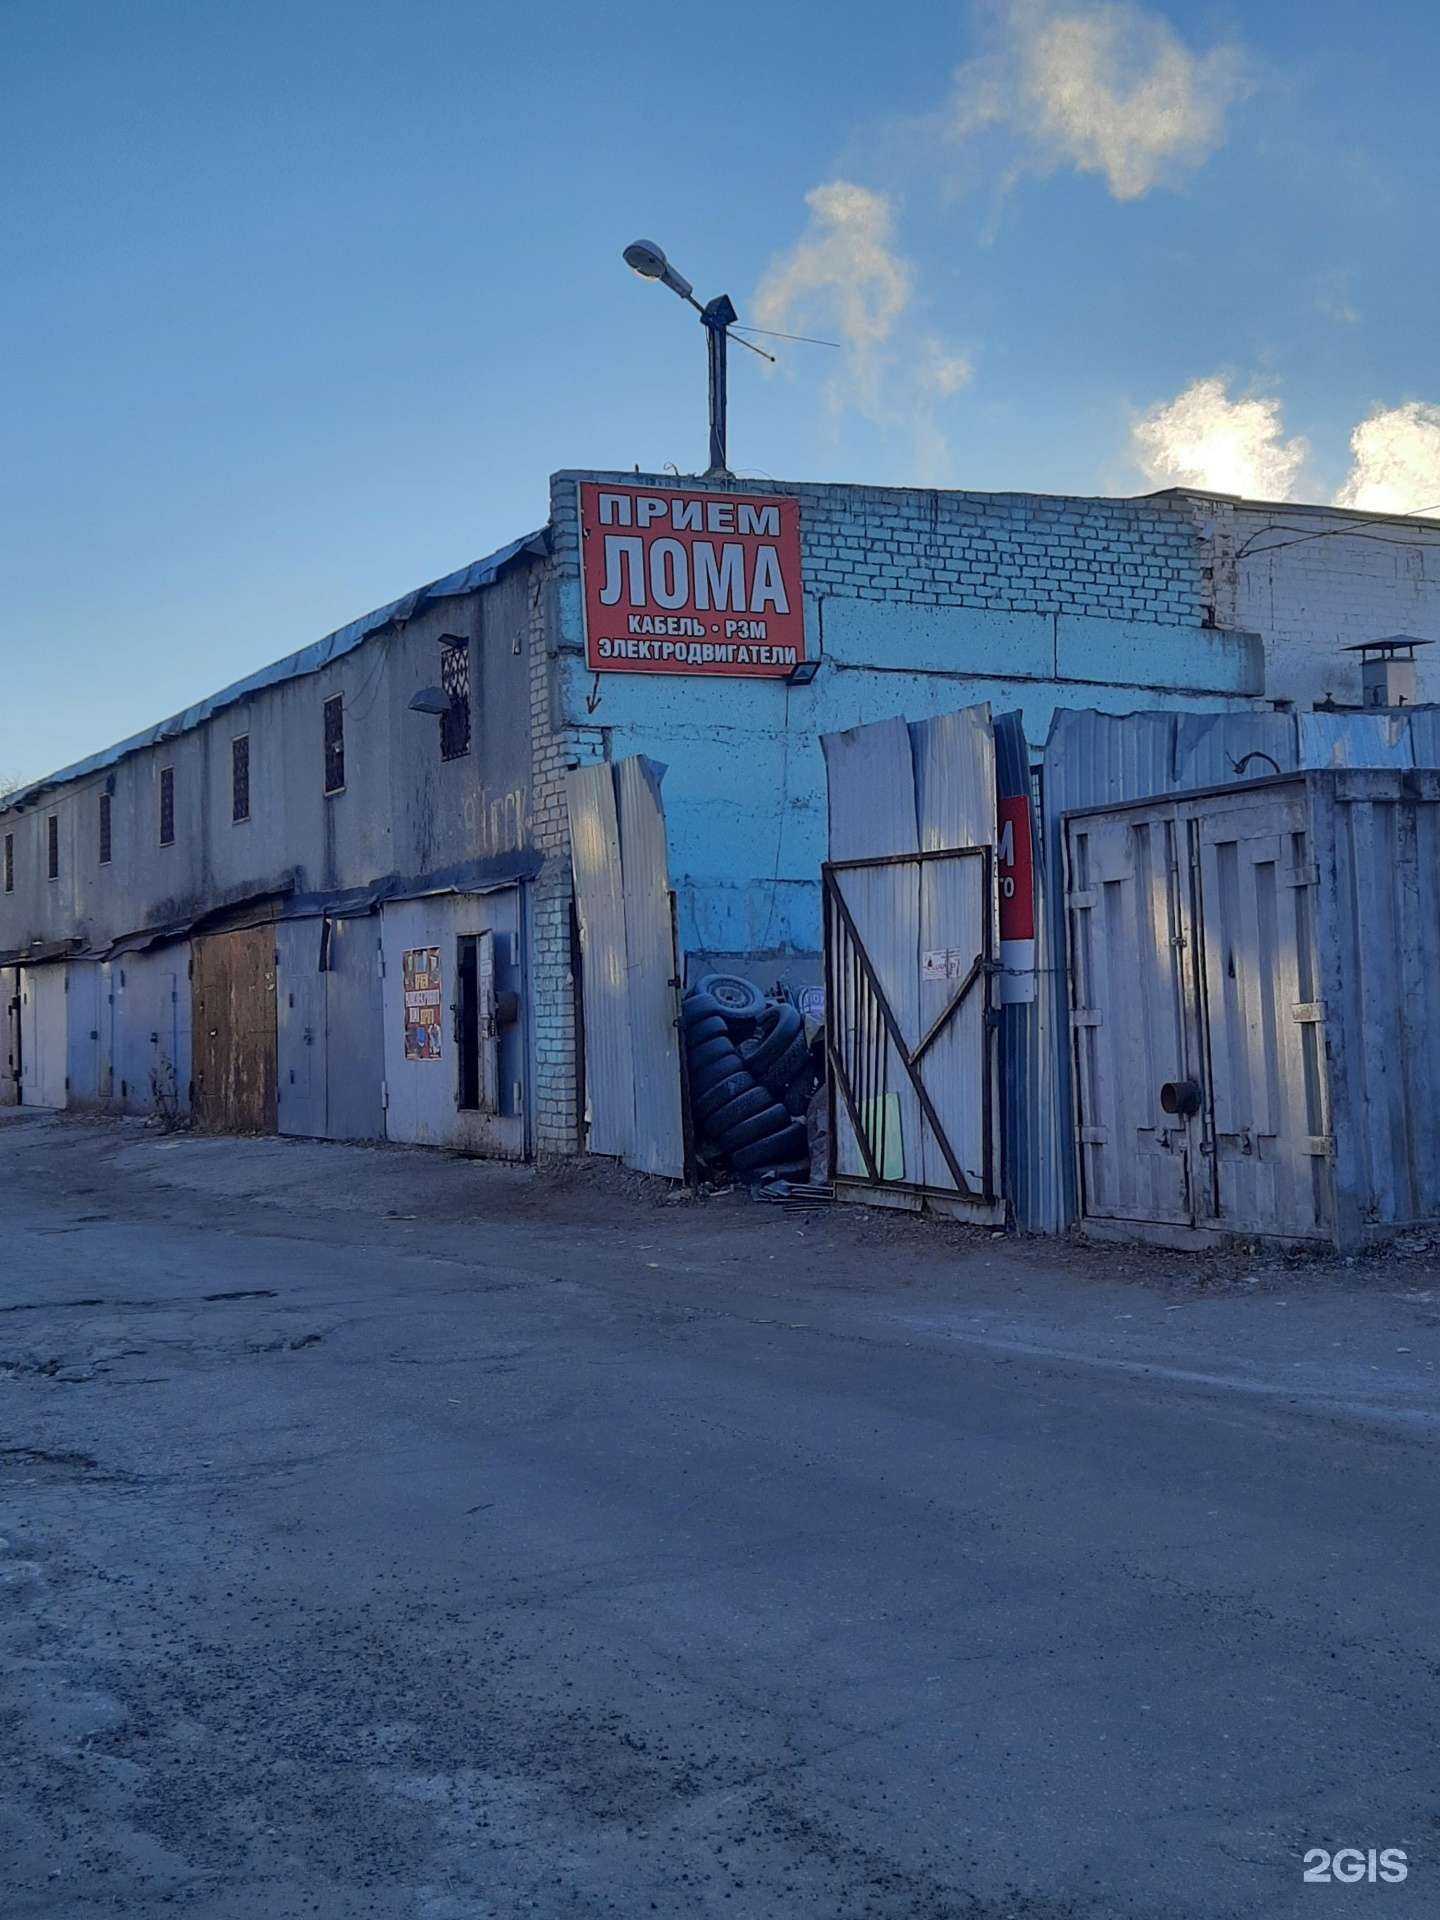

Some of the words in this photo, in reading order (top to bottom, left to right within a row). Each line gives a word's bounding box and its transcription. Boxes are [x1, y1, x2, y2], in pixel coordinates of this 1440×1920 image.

[598, 493, 781, 536] ПРИЕМ
[599, 534, 791, 614] ЛОМА
[628, 614, 706, 637] КАБЕЛЬ
[598, 638, 797, 665] ЭЛЕКТРОДВИГАТЕЛИ
